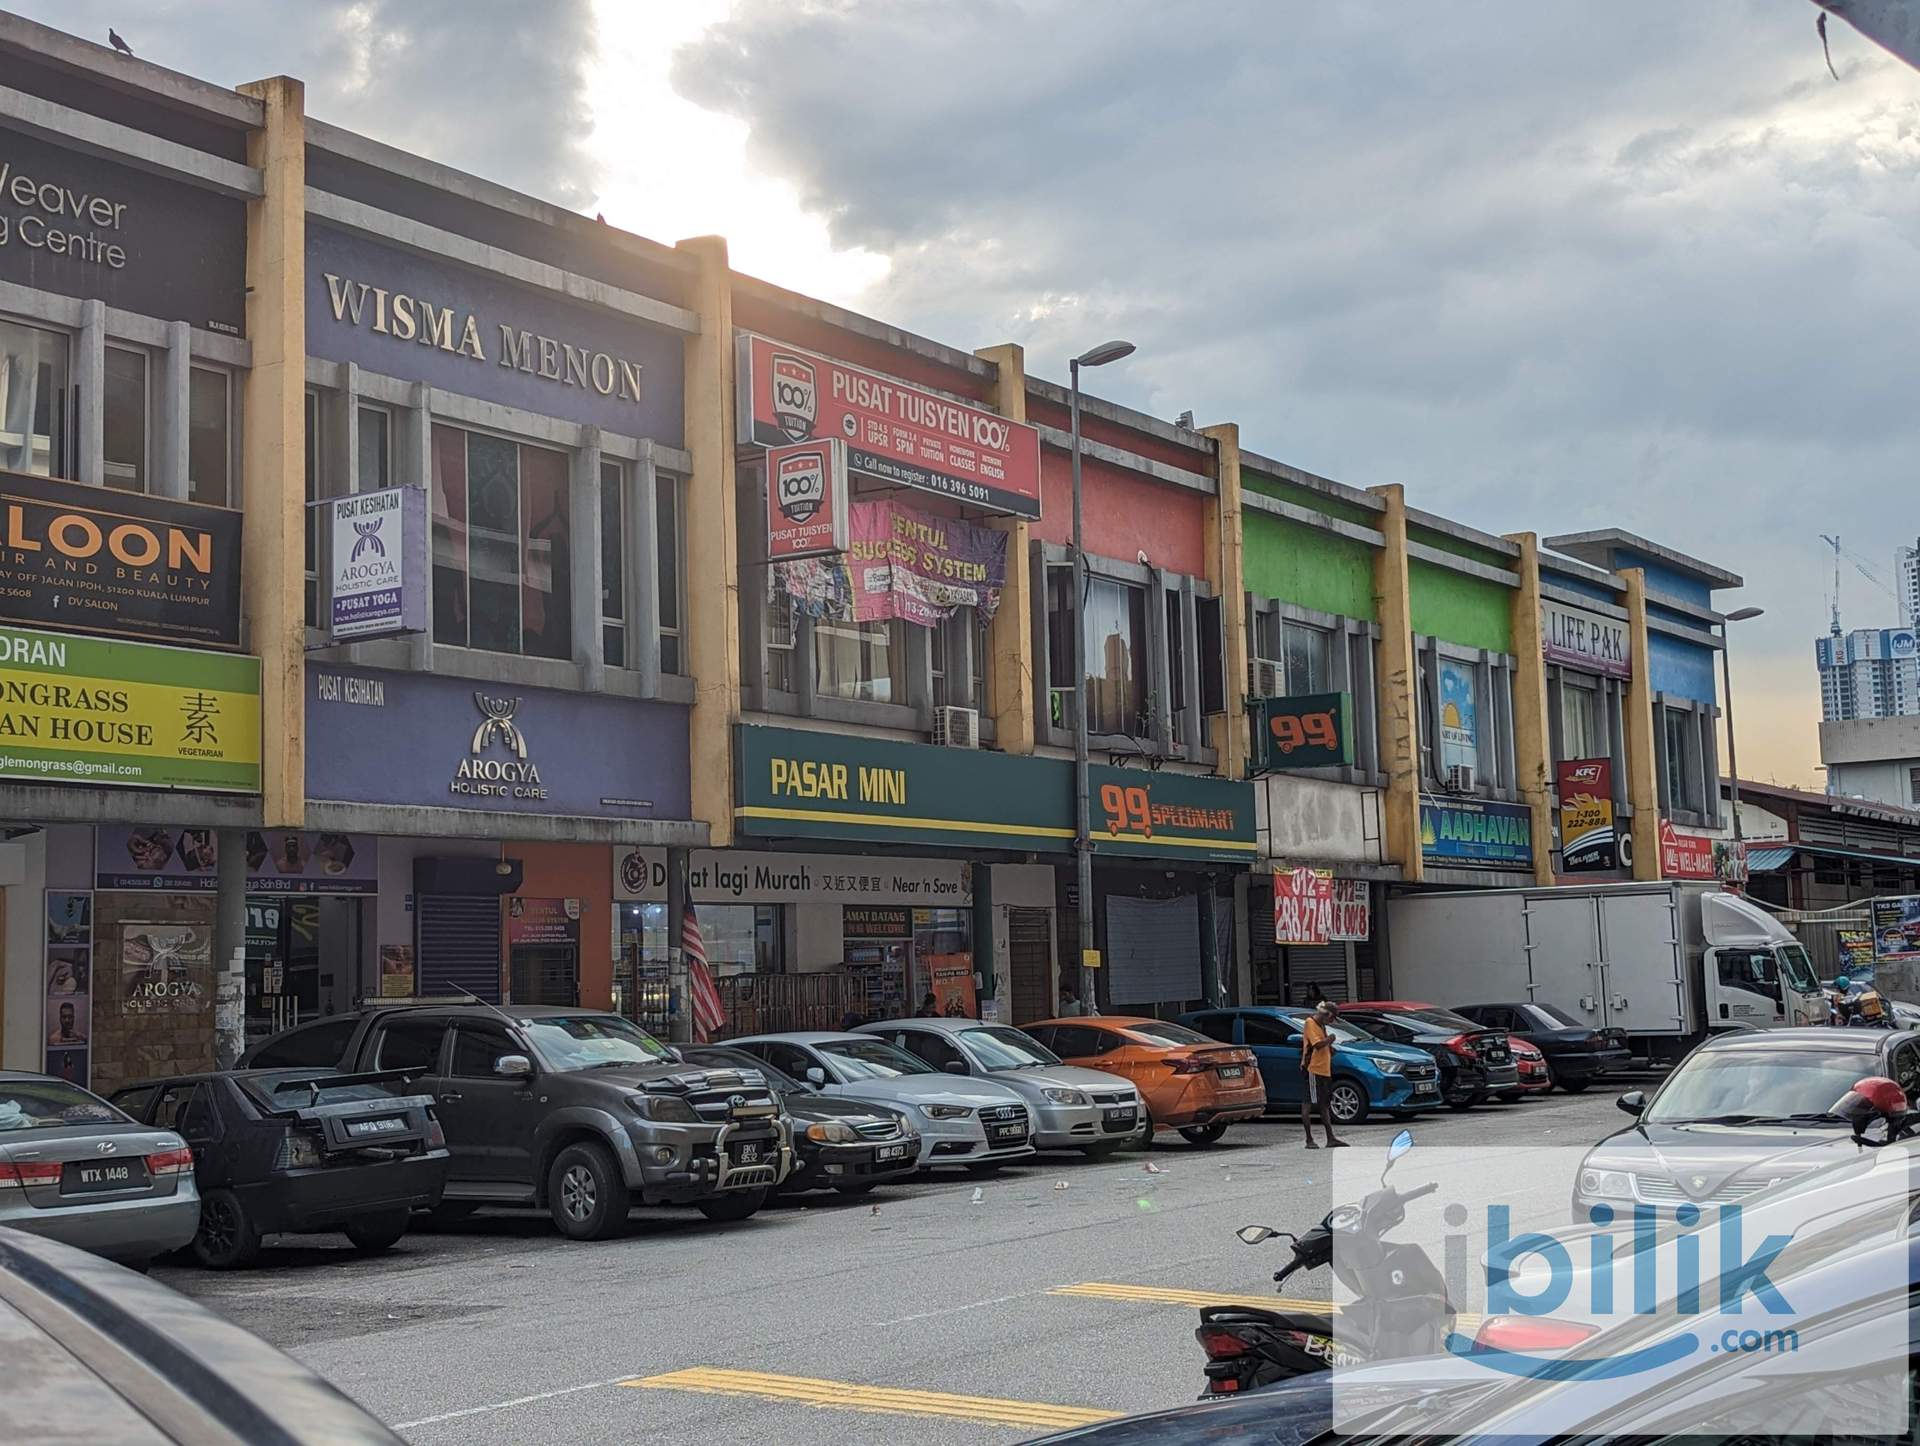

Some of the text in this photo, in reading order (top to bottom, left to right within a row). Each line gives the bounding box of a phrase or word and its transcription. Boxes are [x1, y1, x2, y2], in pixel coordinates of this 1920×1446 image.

[0, 163, 127, 229] eaver
[19, 215, 126, 268] Centre
[324, 273, 643, 402] WISMA MENON
[777, 381, 813, 413] 100%
[832, 370, 1010, 452] PUSAT TUISYEN 100%
[868, 431, 888, 448] UPSR
[896, 438, 914, 455] SPM
[920, 447, 945, 462] TUITION
[950, 456, 976, 472] CLASSES
[783, 474, 820, 497] 100%
[864, 457, 877, 470] Call
[878, 462, 892, 474] now
[893, 466, 900, 477] to
[931, 475, 947, 489] 016
[950, 480, 966, 494] 396
[969, 485, 989, 500] 5091
[980, 464, 1005, 480] ENGLISH
[337, 493, 400, 520] PUSAT KESIHATAN
[0, 505, 213, 575] LOON
[770, 523, 832, 541] PUSAT TUISYEN
[45, 558, 97, 575] AND
[116, 568, 210, 591] BEAUTY
[340, 561, 395, 581] AROGYA
[923, 552, 987, 582] SYSTEM
[41, 576, 74, 588] JALAN
[136, 589, 168, 600] KUALA
[170, 593, 210, 606] LUMPUR
[336, 576, 399, 592] HOLISTIC CARE
[68, 597, 83, 607] DV
[85, 599, 118, 611] SALON
[341, 592, 398, 611] PUSAT YOGA
[1552, 611, 1622, 662] LIFE PAK
[1893, 639, 1914, 649] IJM
[0, 680, 129, 713] NGRASS
[319, 674, 384, 707] PUSAT KESIHATAN
[50, 717, 153, 746] HOUSE
[179, 692, 220, 744] 素
[1270, 710, 1338, 754] 99
[178, 747, 224, 758] VEGETARIAN
[457, 759, 541, 784] AROGYA
[771, 758, 906, 805] PASAR MINI
[1575, 767, 1596, 777] KFC
[451, 782, 549, 799] HOLISTIC CARE
[1100, 784, 1234, 839] 99 SPEEDMART
[1440, 811, 1529, 847] AADHAVAN
[715, 862, 749, 895] lagi
[755, 865, 811, 891] Murah
[822, 874, 881, 892] 又近又便宜
[892, 876, 919, 893] Near
[933, 877, 957, 893] Save
[1291, 867, 1316, 896] 012
[133, 982, 201, 997] AROGYA
[81, 1166, 128, 1182] WTX 1448
